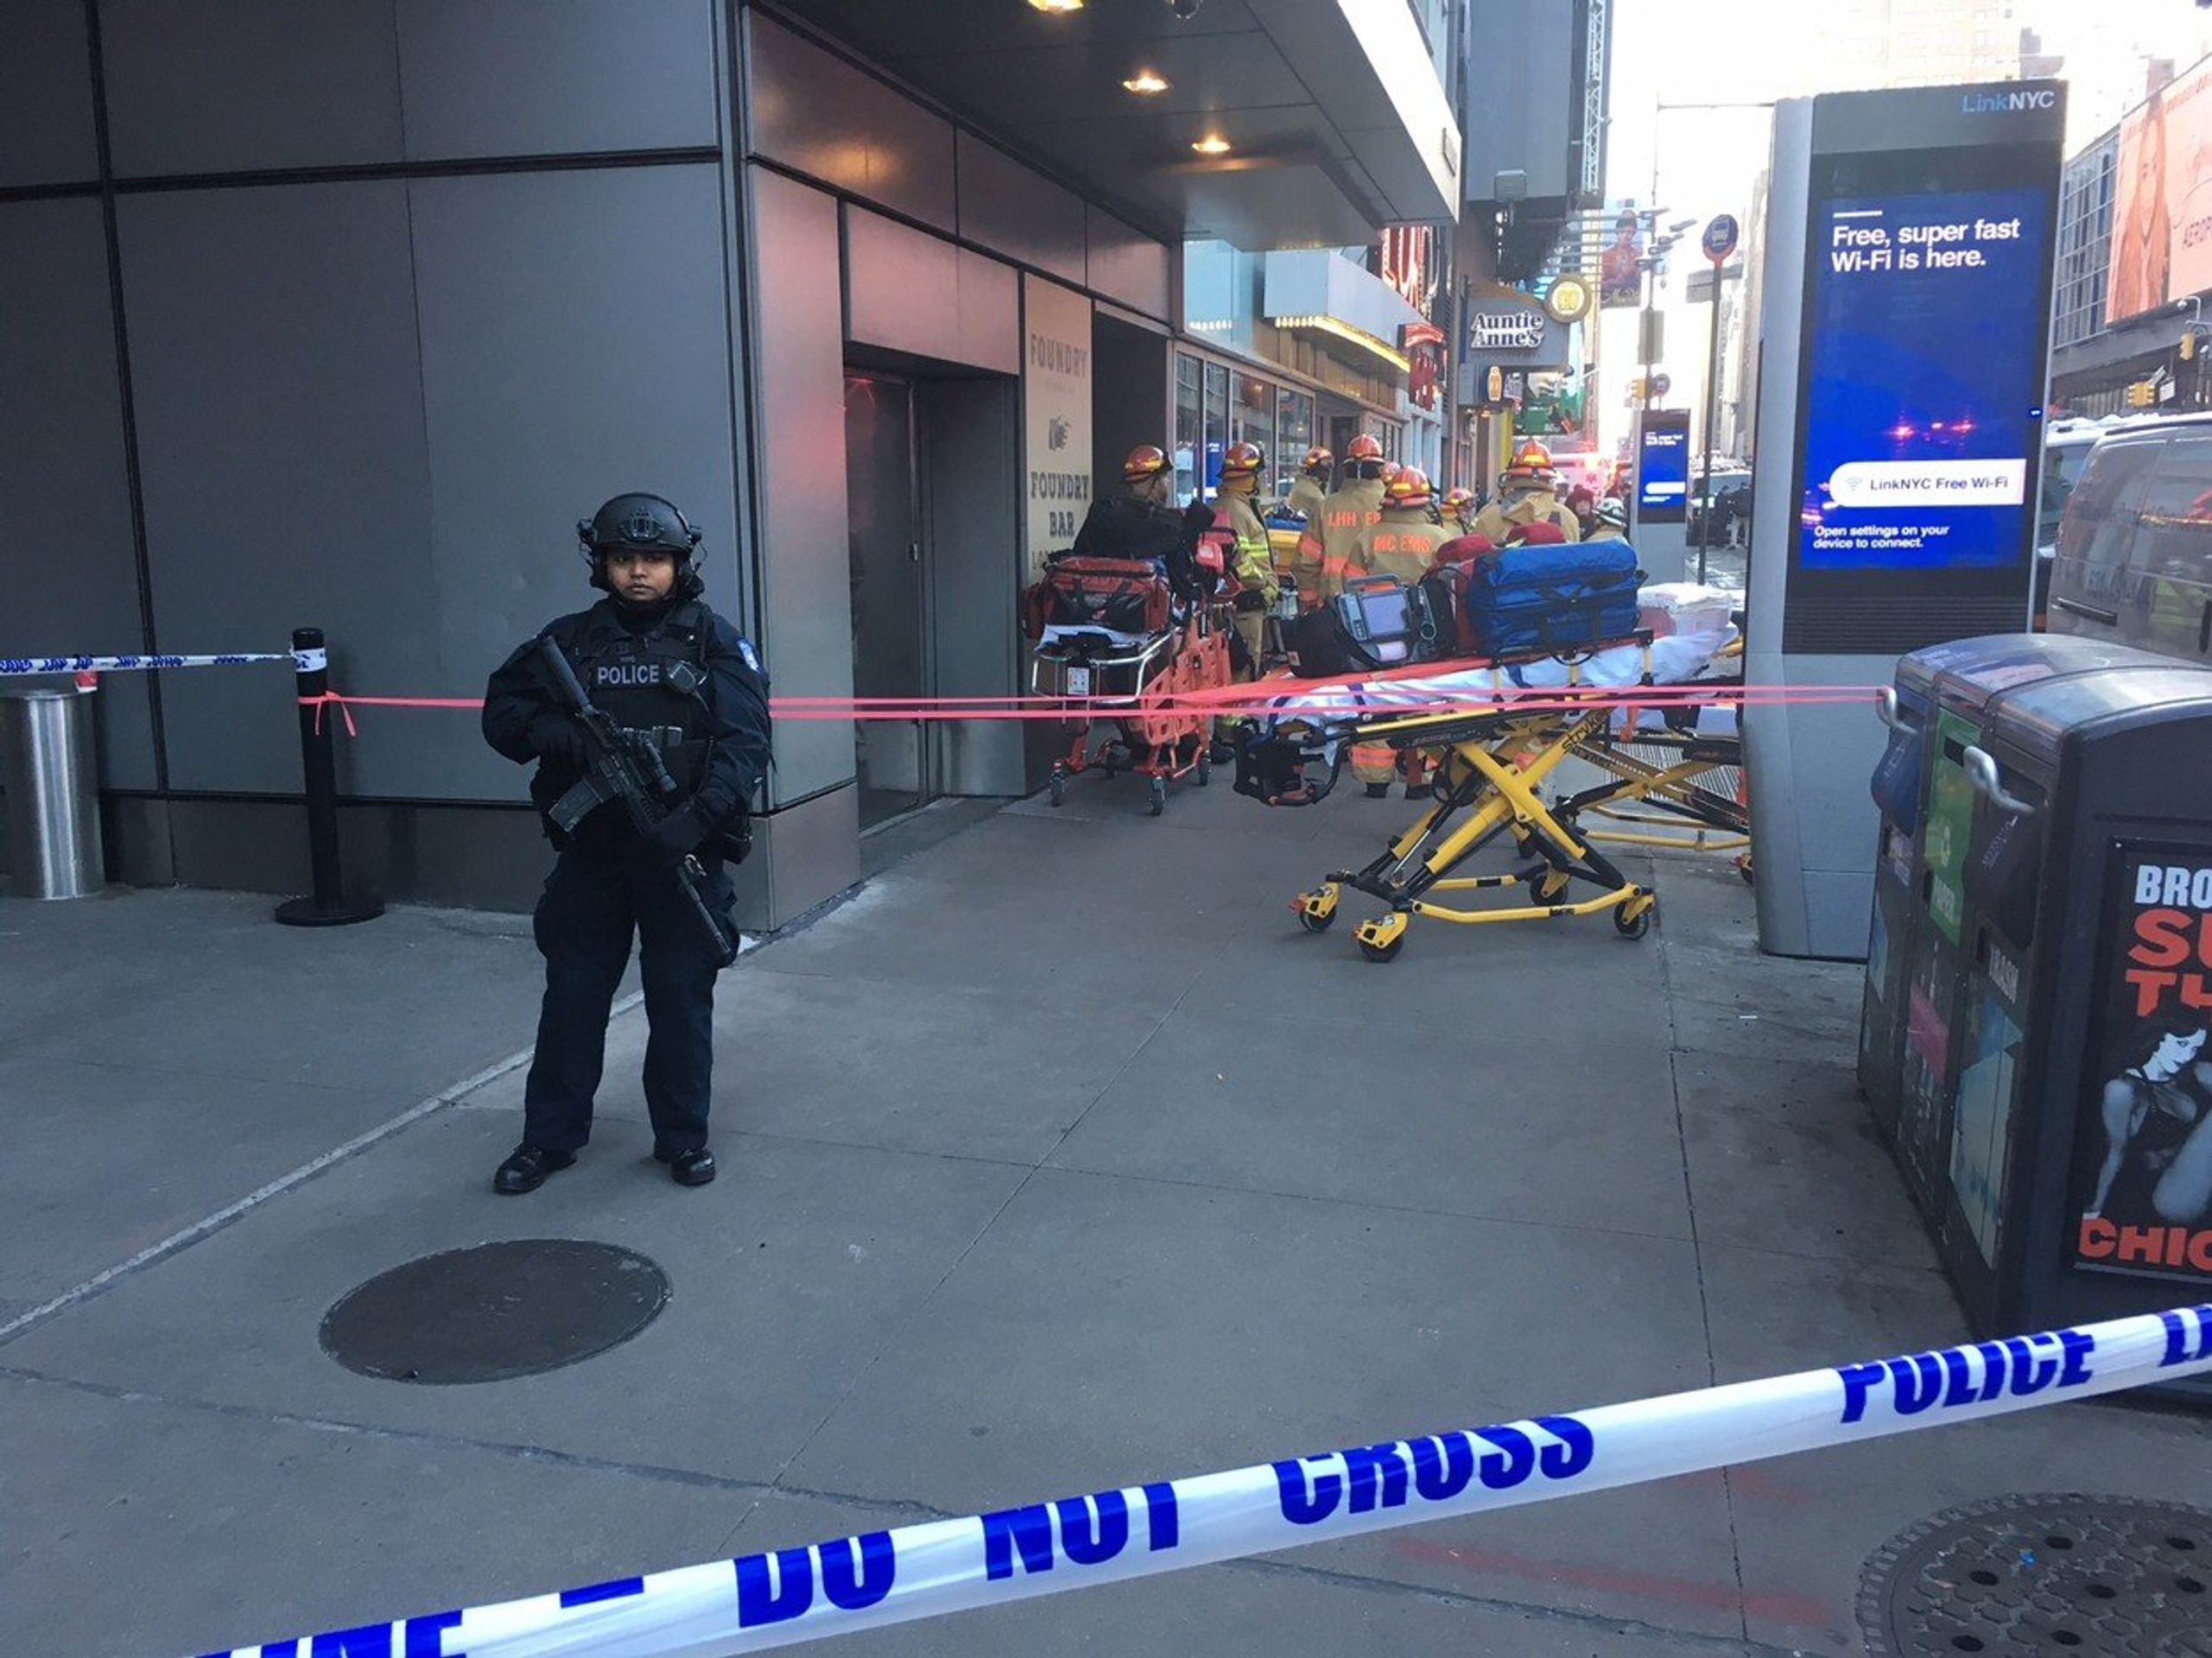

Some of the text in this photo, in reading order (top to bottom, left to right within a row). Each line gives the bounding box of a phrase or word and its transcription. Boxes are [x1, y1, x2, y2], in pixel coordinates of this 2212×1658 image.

[1962, 90, 2055, 112] LinkNYC
[1833, 218, 2020, 248] Free, super fast
[1831, 247, 1987, 272] Wi-Fi is here.
[1472, 311, 1544, 331] Auntie
[1471, 329, 1544, 347] Anne's
[1030, 332, 1087, 378] FOUNDRY
[1030, 471, 1089, 499] FOUNDRY
[1870, 476, 2008, 490] LinkNYC Free Wi-Fi
[1049, 511, 1074, 537] BAR
[1815, 524, 1949, 538] Open settings on your
[1813, 537, 1924, 549] device to connect.
[598, 664, 659, 685] POLICE
[2134, 864, 2212, 908] BRO
[2127, 908, 2212, 968] S
[1272, 1414, 1594, 1526] CROSS
[1838, 1327, 2095, 1424] POLICE
